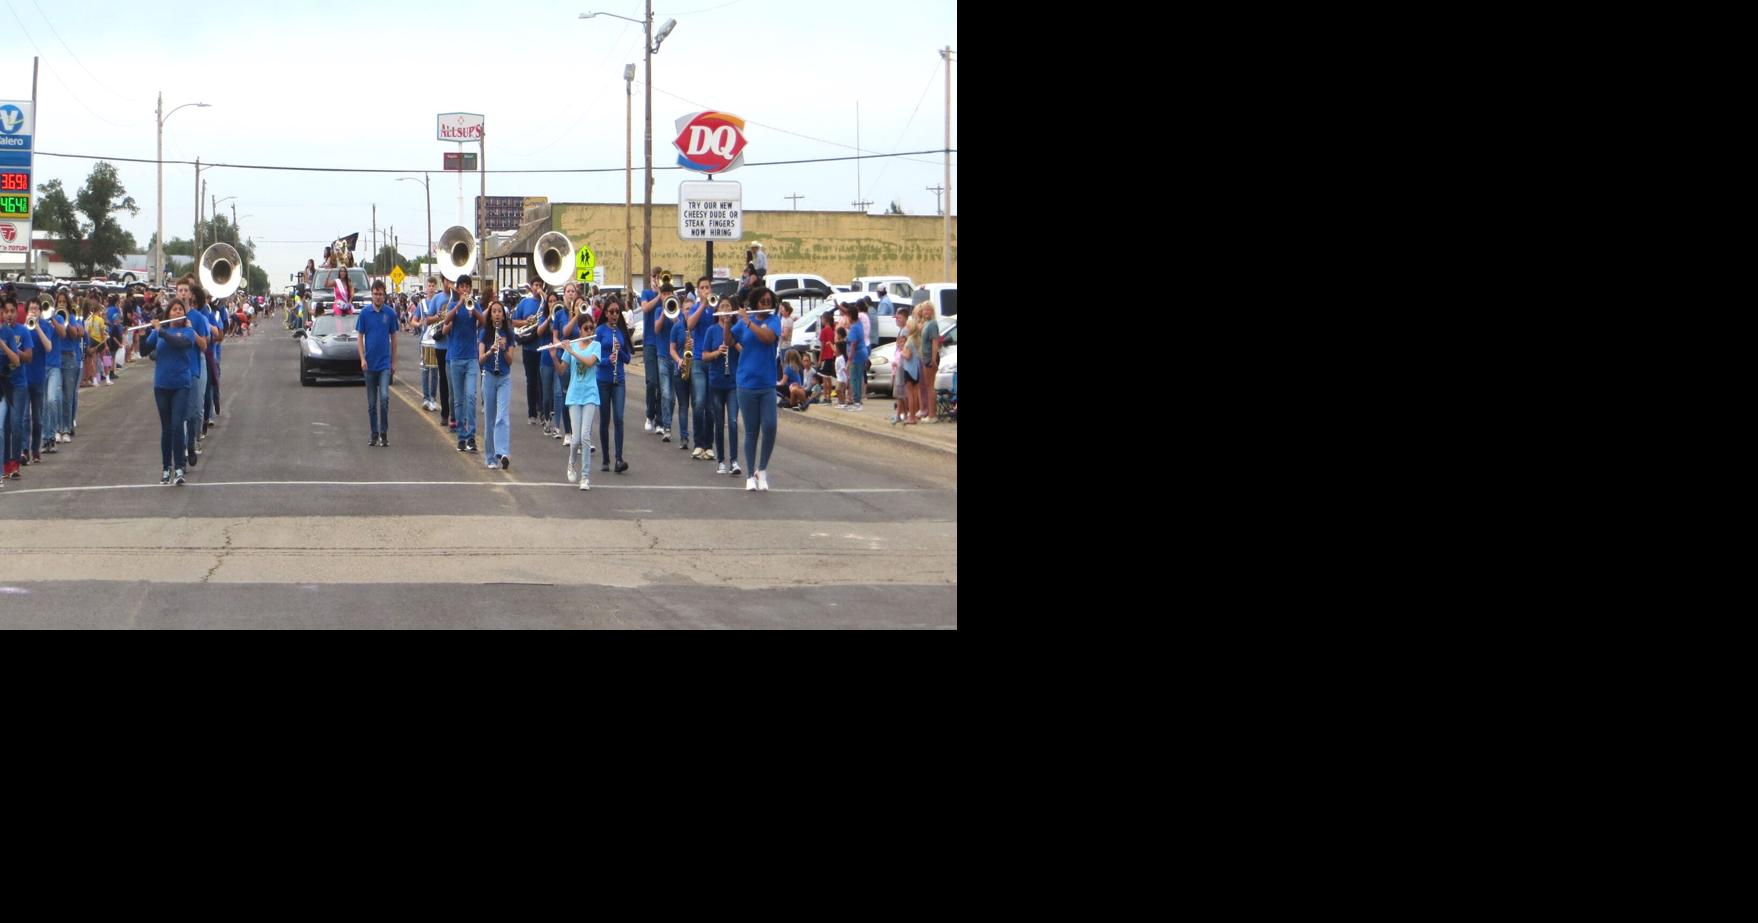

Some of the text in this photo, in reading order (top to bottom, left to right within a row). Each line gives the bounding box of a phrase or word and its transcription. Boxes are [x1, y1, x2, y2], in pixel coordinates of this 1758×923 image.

[0, 136, 24, 146] alero
[687, 125, 736, 160] DQ
[688, 201, 733, 210] TRY OUR NEW
[683, 210, 738, 219] CHEESY DUDE OR
[684, 219, 735, 228] STEAK FINGERS
[691, 228, 732, 237] NOW HIRING
